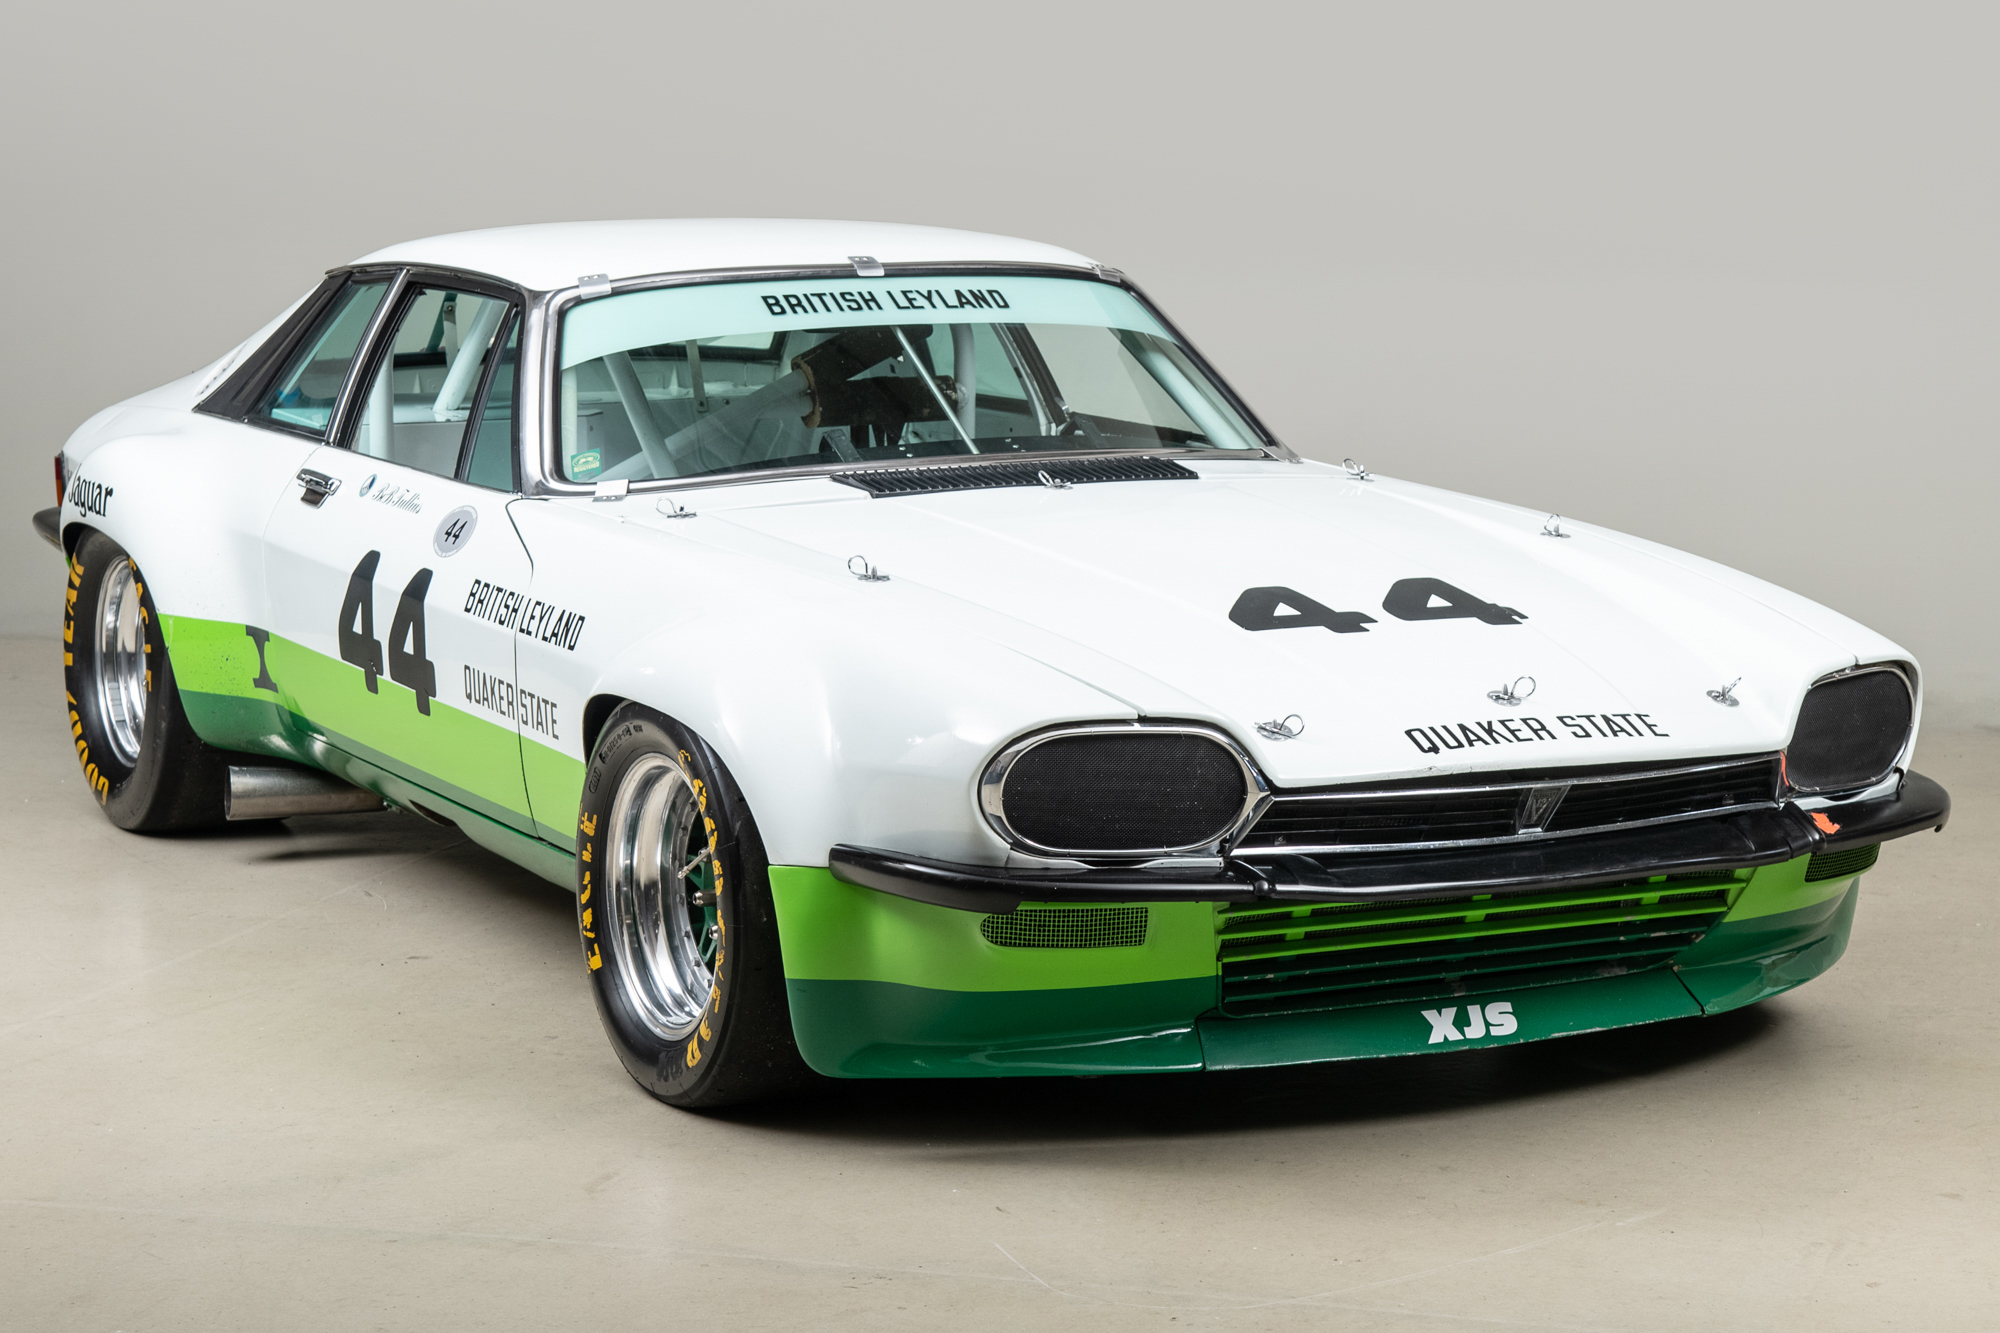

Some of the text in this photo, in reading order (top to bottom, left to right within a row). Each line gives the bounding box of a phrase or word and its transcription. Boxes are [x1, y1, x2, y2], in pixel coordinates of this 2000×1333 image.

[761, 289, 1010, 316] BRITISH LEYLAND
[68, 463, 113, 517] Jaguar
[444, 518, 468, 545] 44
[464, 578, 585, 651] BRITISH LEYLAND
[1228, 577, 1529, 633] 44
[338, 550, 436, 717] 44
[464, 665, 559, 740] QUAKER STATE
[1404, 713, 1670, 755] QUAKER STATE
[1421, 1001, 1518, 1044] XJS
